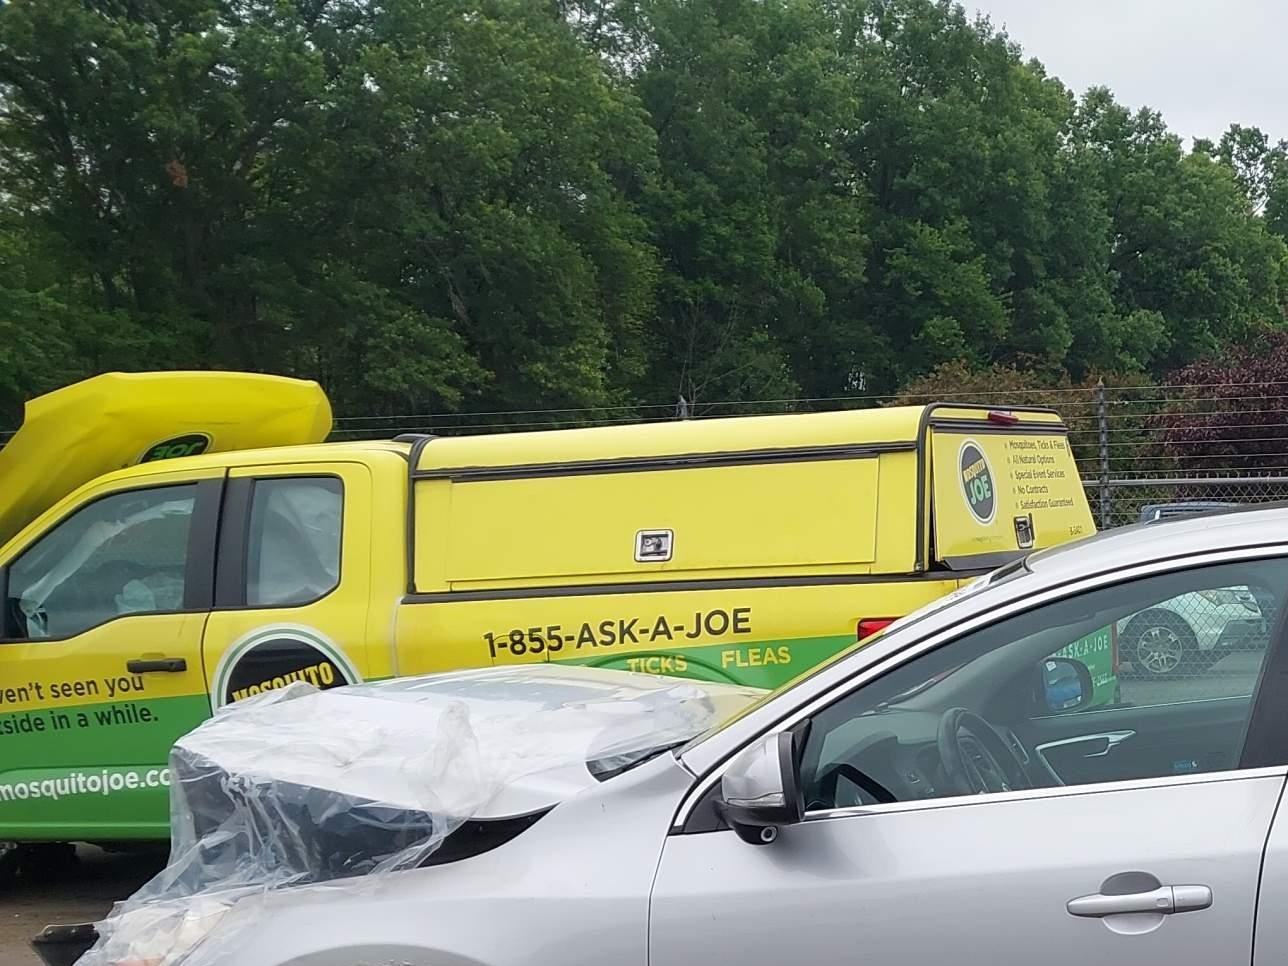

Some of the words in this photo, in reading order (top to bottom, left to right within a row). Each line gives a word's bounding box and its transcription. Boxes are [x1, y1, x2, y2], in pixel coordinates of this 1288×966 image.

[1036, 454, 1055, 465] Options
[1014, 469, 1033, 480] Special
[1033, 469, 1046, 479] Event
[1046, 469, 1065, 478] Services
[970, 474, 992, 505] JOE
[1017, 485, 1026, 494] No
[1026, 484, 1048, 494] Contracts
[483, 607, 752, 658] 1-855-ASK-A-JOE
[626, 655, 688, 674] TICKS
[720, 646, 791, 669] FLEAS
[50, 679, 99, 698] seen
[104, 675, 144, 697] you
[49, 710, 70, 730] in
[77, 712, 89, 728] a
[95, 703, 159, 726] while.
